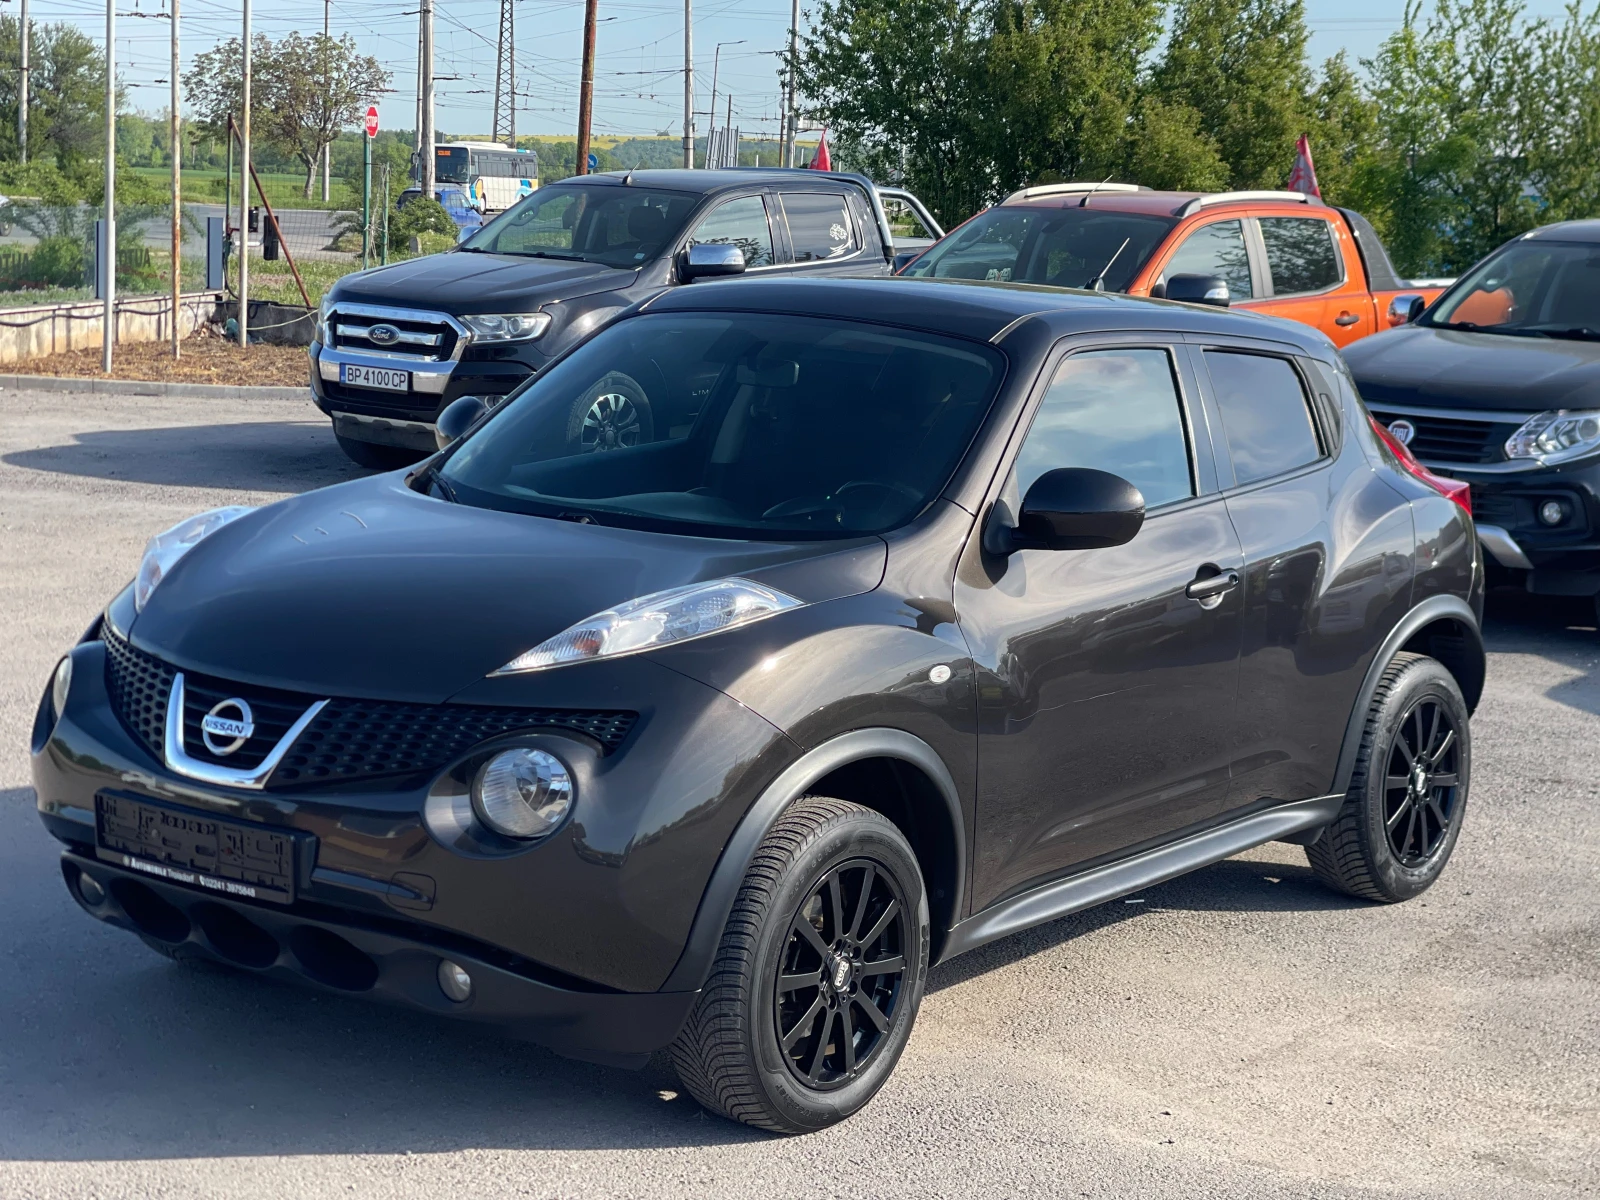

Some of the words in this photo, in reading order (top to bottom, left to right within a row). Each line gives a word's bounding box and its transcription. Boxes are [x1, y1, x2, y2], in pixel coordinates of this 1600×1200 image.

[366, 115, 378, 127] STOP
[372, 328, 391, 340] Ford
[347, 367, 362, 382] BP
[363, 369, 390, 386] 4100
[391, 373, 406, 388] CP
[1393, 427, 1409, 441] FIAT
[205, 718, 244, 734] NISSAN
